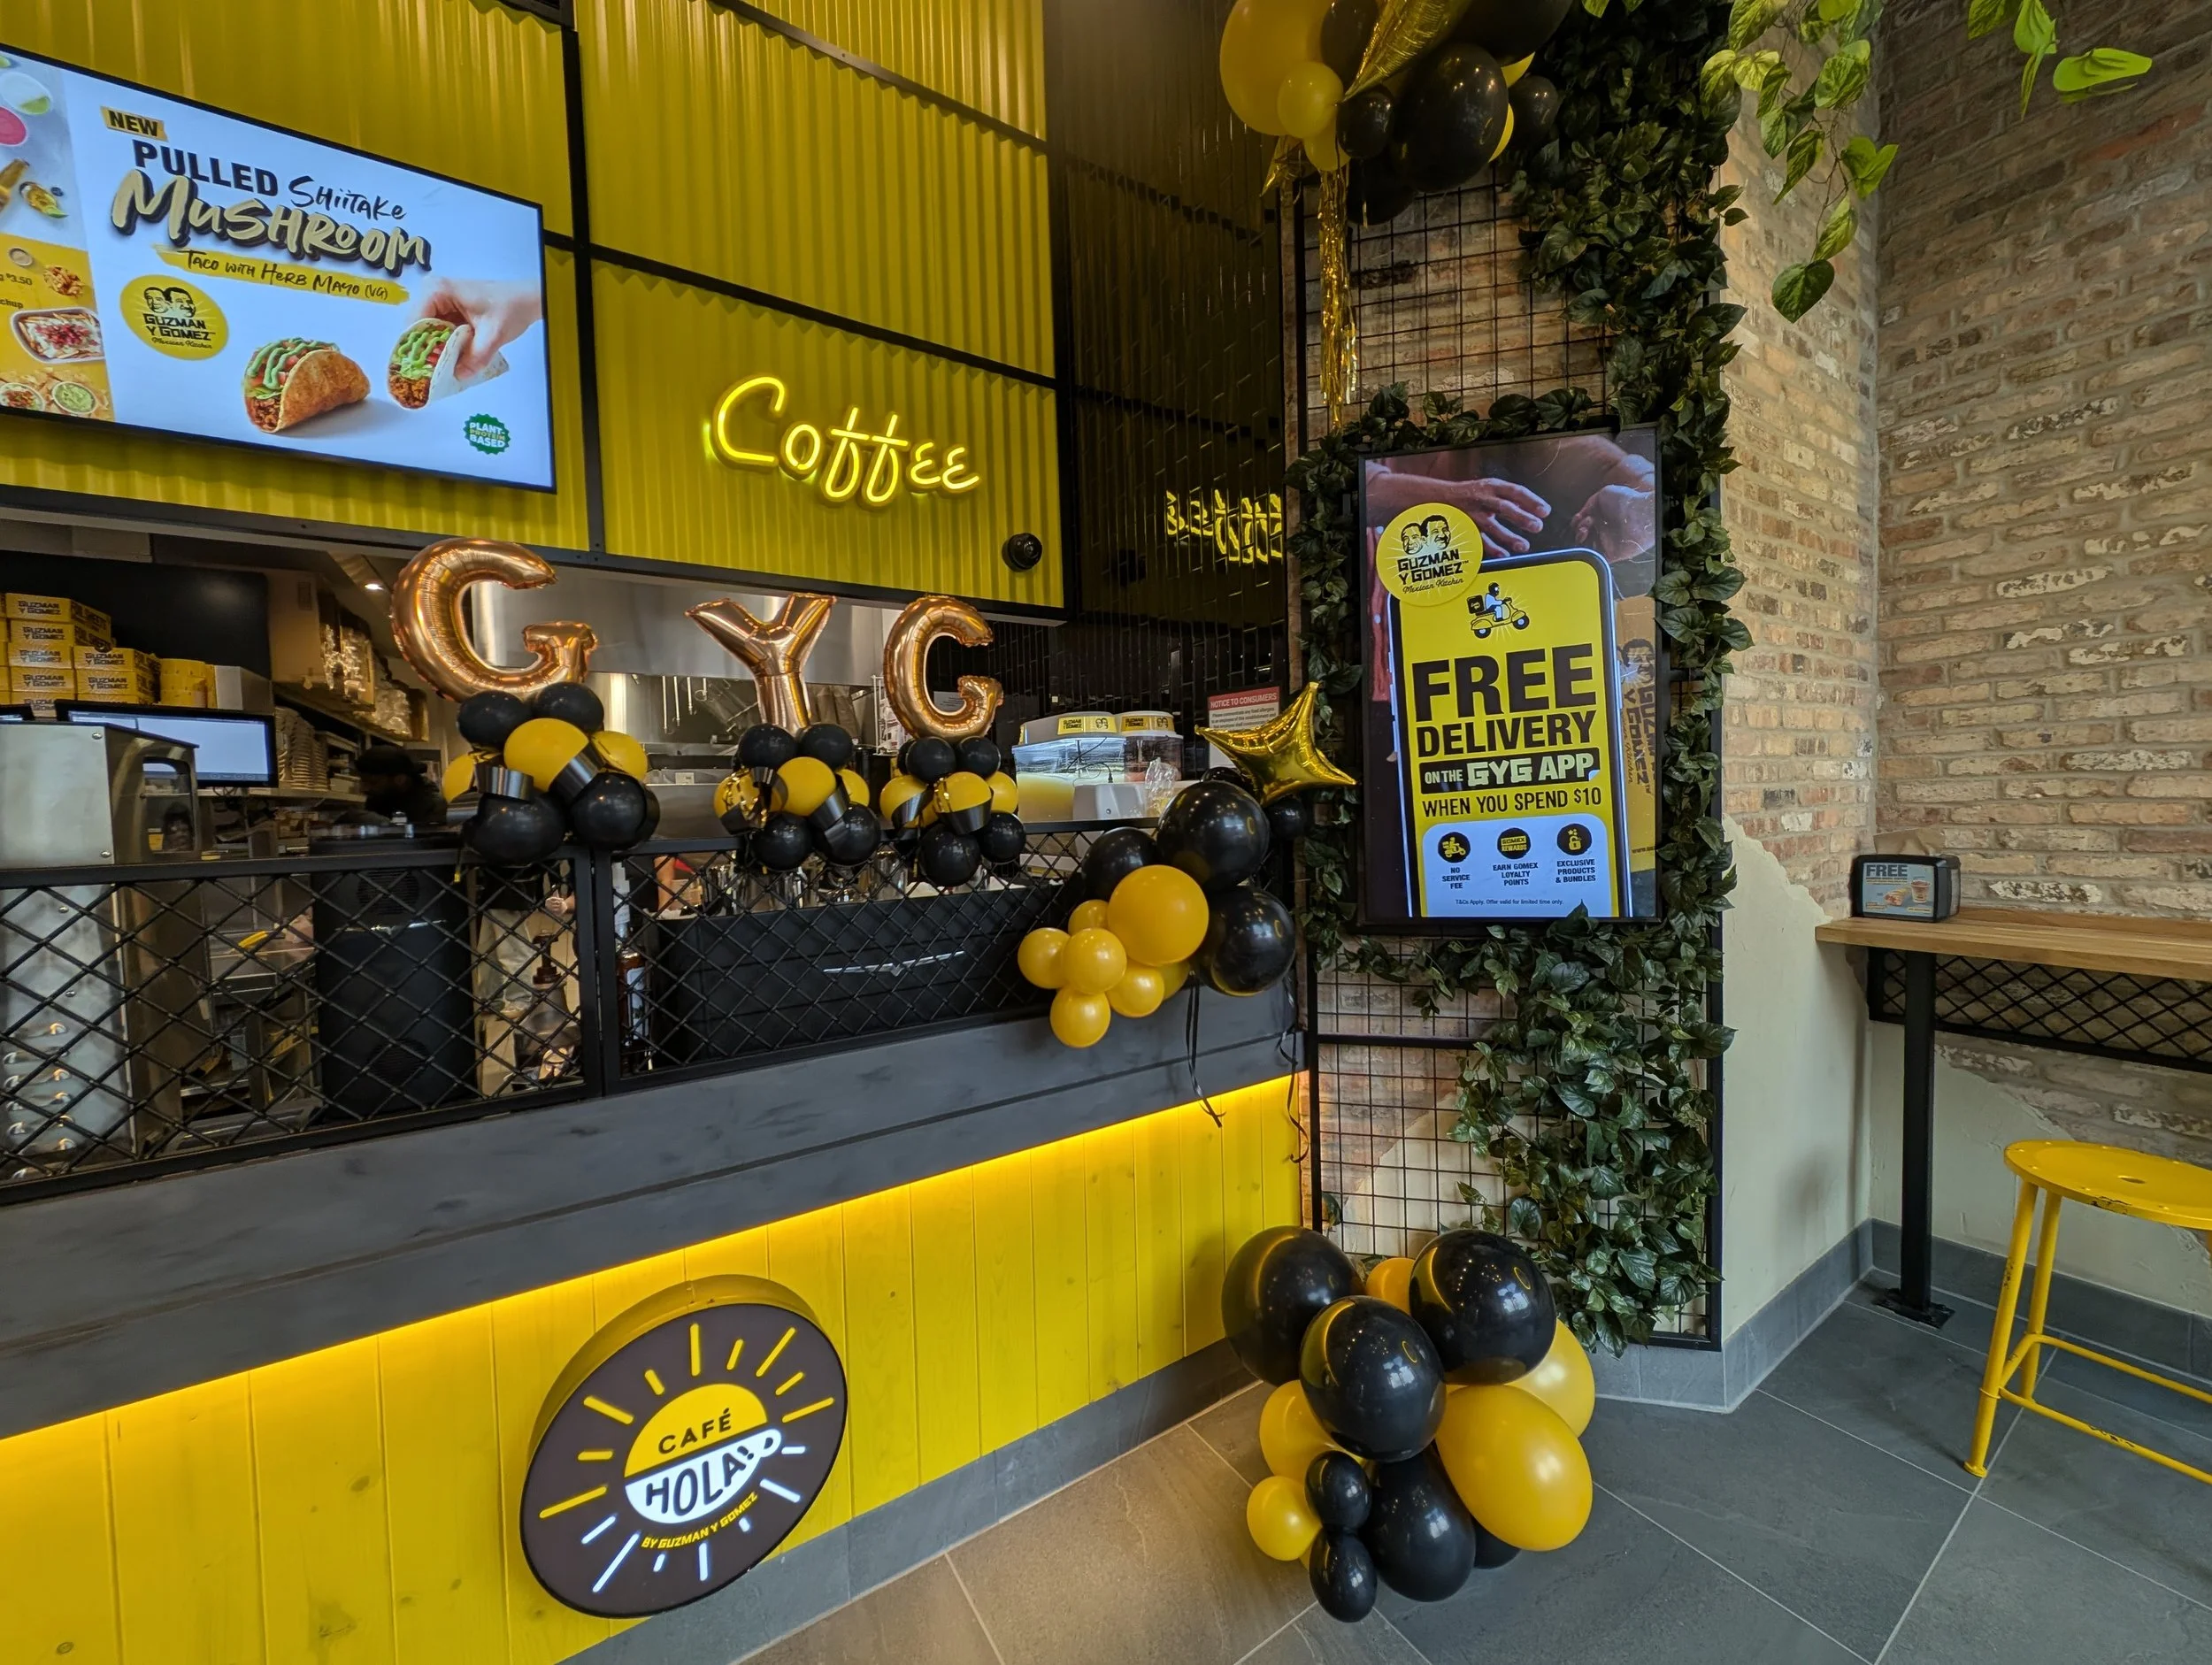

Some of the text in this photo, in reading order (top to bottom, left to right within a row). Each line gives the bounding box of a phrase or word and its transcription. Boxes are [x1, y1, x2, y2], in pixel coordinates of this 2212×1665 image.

[108, 111, 158, 137] NEW
[132, 139, 278, 196] PULLED
[365, 284, 388, 300] (VG)
[142, 313, 206, 329] GUZMAN
[146, 326, 211, 341] Y GOMEZ
[469, 434, 505, 448] BASED
[711, 374, 984, 506] Coffee
[1397, 549, 1460, 572] GUZMAN
[1398, 572, 1409, 585] Y
[1402, 577, 1464, 595] Mexican Kitchen
[1412, 643, 1596, 722] FREE
[1210, 692, 1278, 709] NOTICE TO CONSUMERS
[1624, 688, 1636, 704] Y
[1417, 710, 1596, 758] DELIVERY
[1424, 752, 1594, 787] ON THE GYG APP
[1422, 786, 1601, 817] WHEN YOU SPEND $10
[1556, 858, 1595, 867] EXCLUSIVE
[1866, 864, 1909, 877] FREE
[1503, 878, 1530, 886] POINTS
[1563, 874, 1596, 883] BUNDLES
[657, 1408, 733, 1455] CAFÉ
[641, 1491, 759, 1549] BY GUZMAN Y GOMEZ
